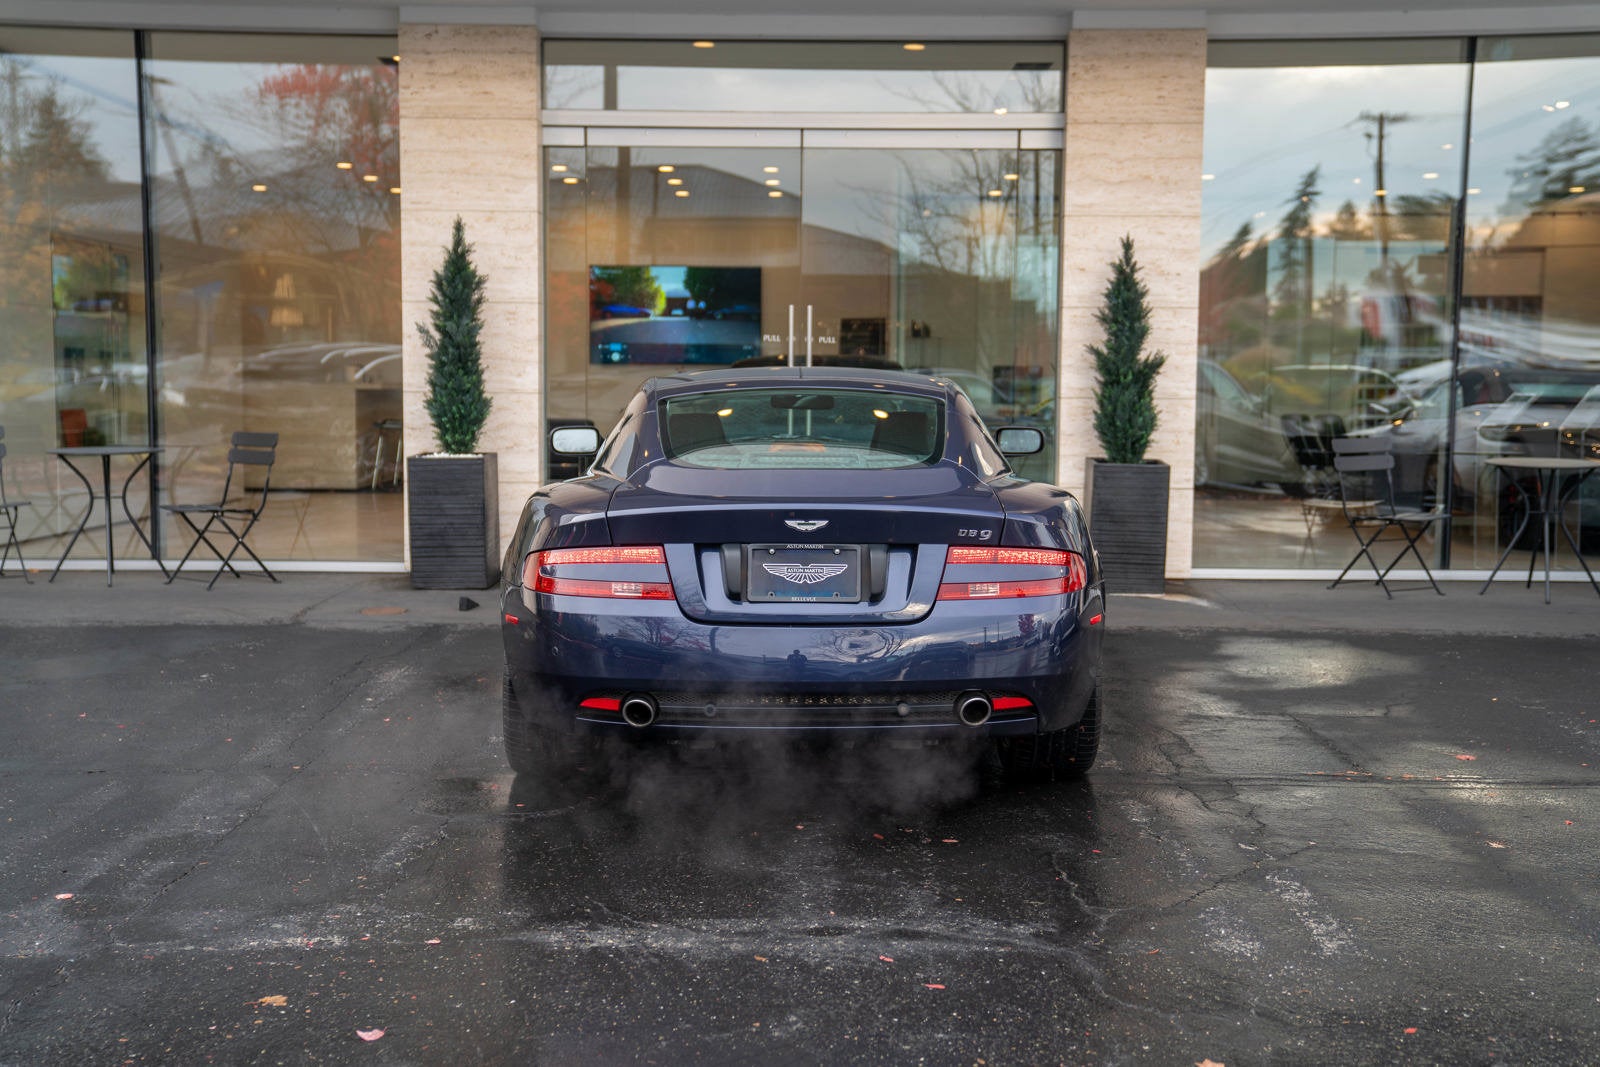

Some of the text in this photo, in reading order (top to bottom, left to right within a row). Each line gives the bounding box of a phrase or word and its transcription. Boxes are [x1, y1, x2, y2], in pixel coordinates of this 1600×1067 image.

[763, 334, 781, 342] PULL
[818, 336, 836, 344] PULL
[958, 529, 992, 540] DB9
